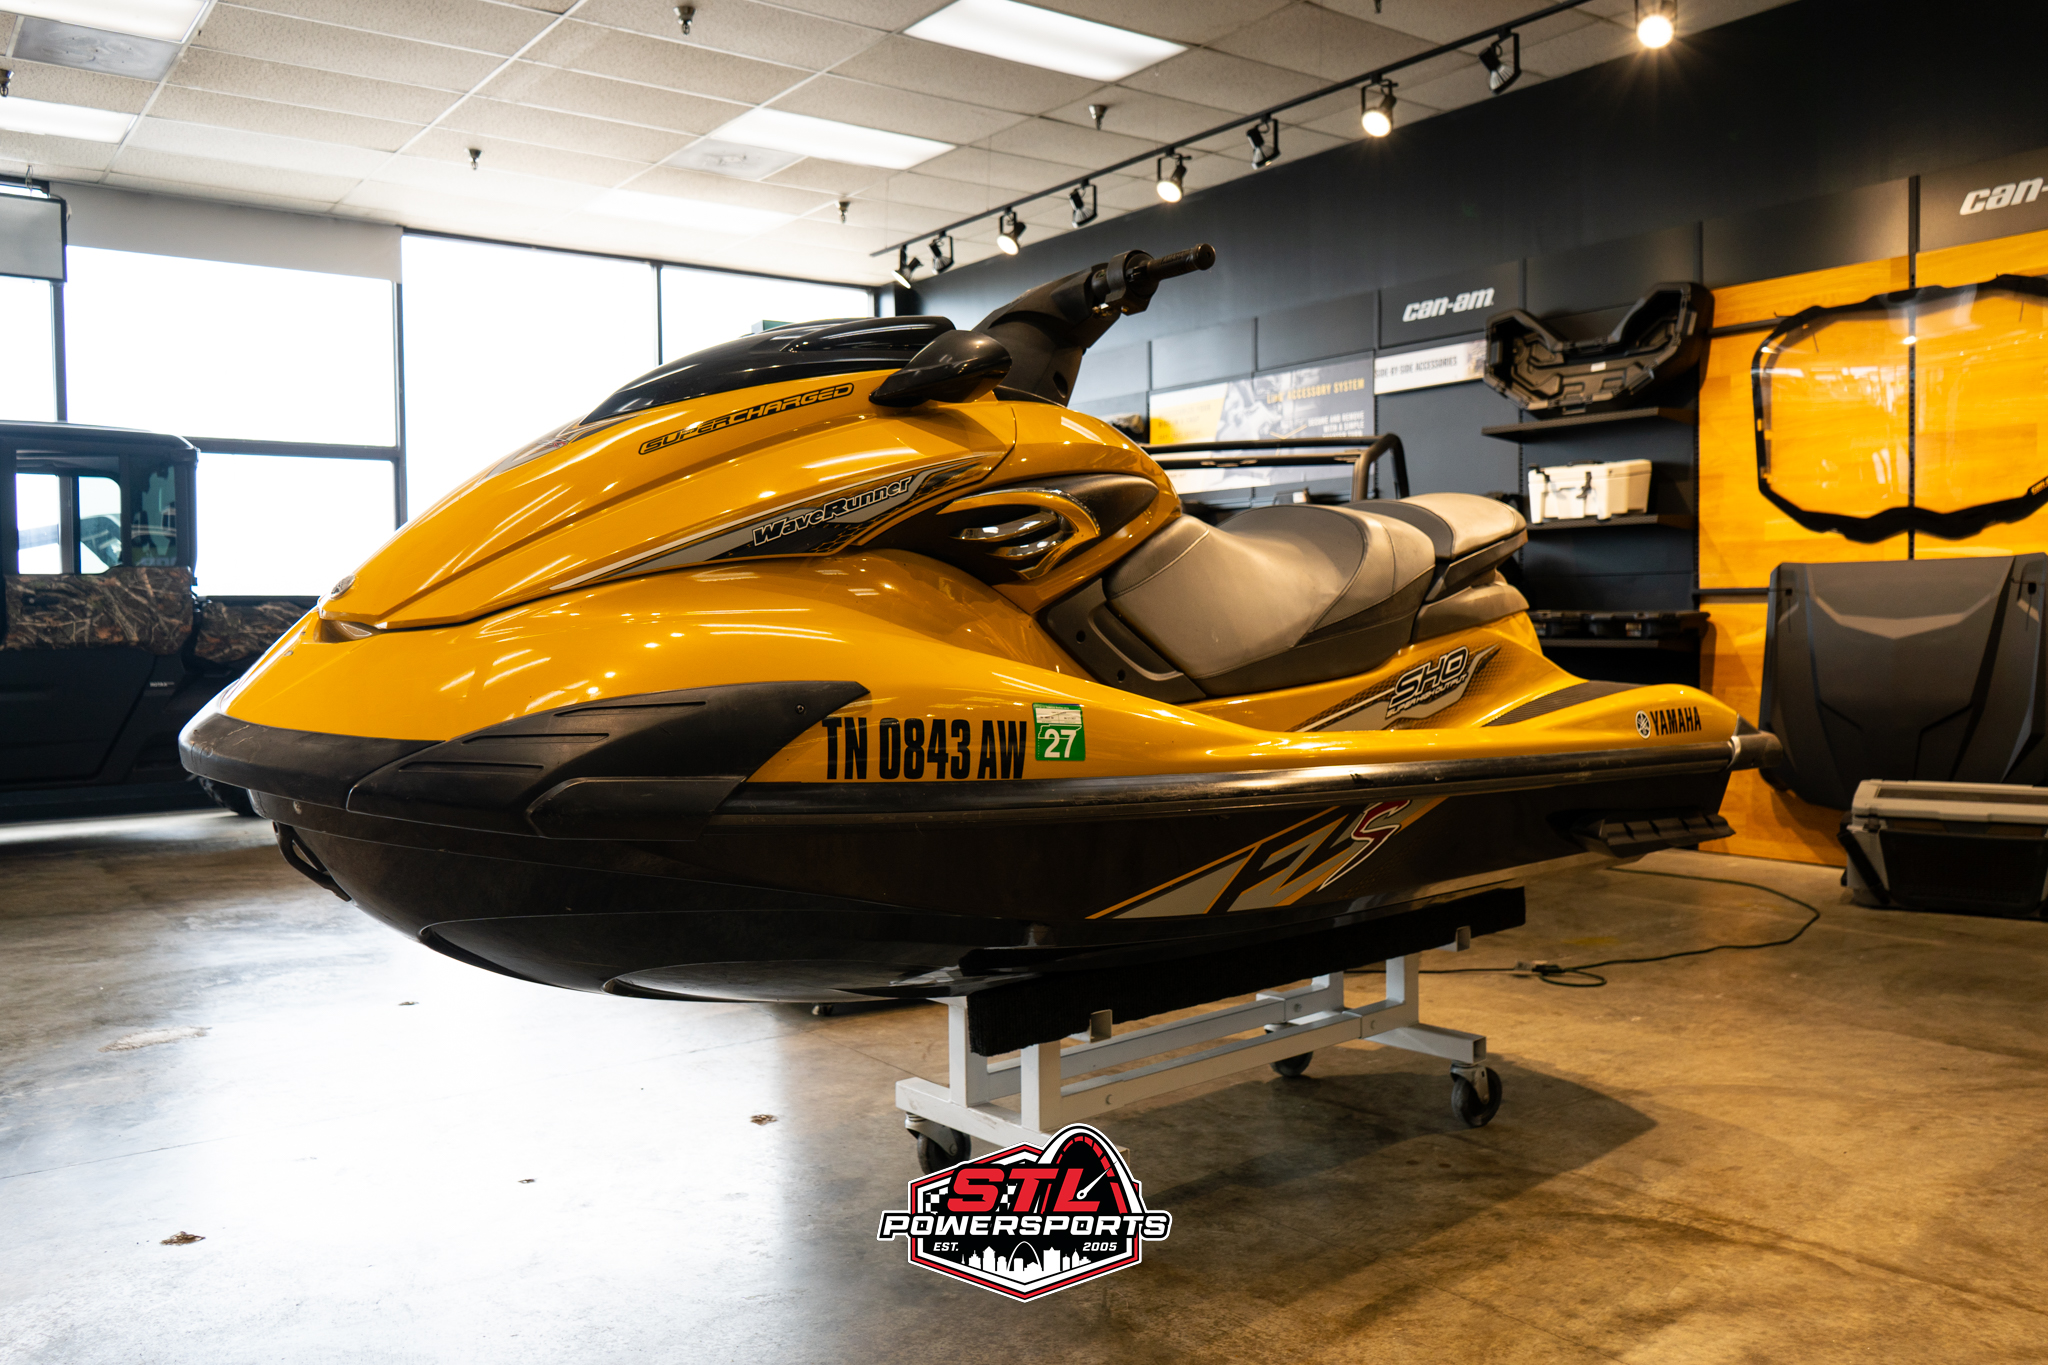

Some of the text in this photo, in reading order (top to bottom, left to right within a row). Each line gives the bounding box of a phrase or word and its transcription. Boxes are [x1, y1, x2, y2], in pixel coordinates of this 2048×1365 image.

[1402, 287, 1495, 323] can-am
[1400, 363, 1414, 375] SIDE
[1415, 356, 1457, 371] ACCESSORIES
[1287, 383, 1331, 401] ACCESSORY
[1333, 378, 1365, 395] SYSTEM
[641, 383, 853, 454] SUPERCHARGED
[752, 475, 914, 546] WaveRunner
[1386, 698, 1416, 718] SUPER
[1434, 673, 1468, 694] OUTPUT
[1388, 646, 1469, 709] SHO
[1650, 706, 1702, 736] YAMAHA
[822, 717, 1027, 780] TN 0843 AW
[1044, 728, 1077, 758] 27
